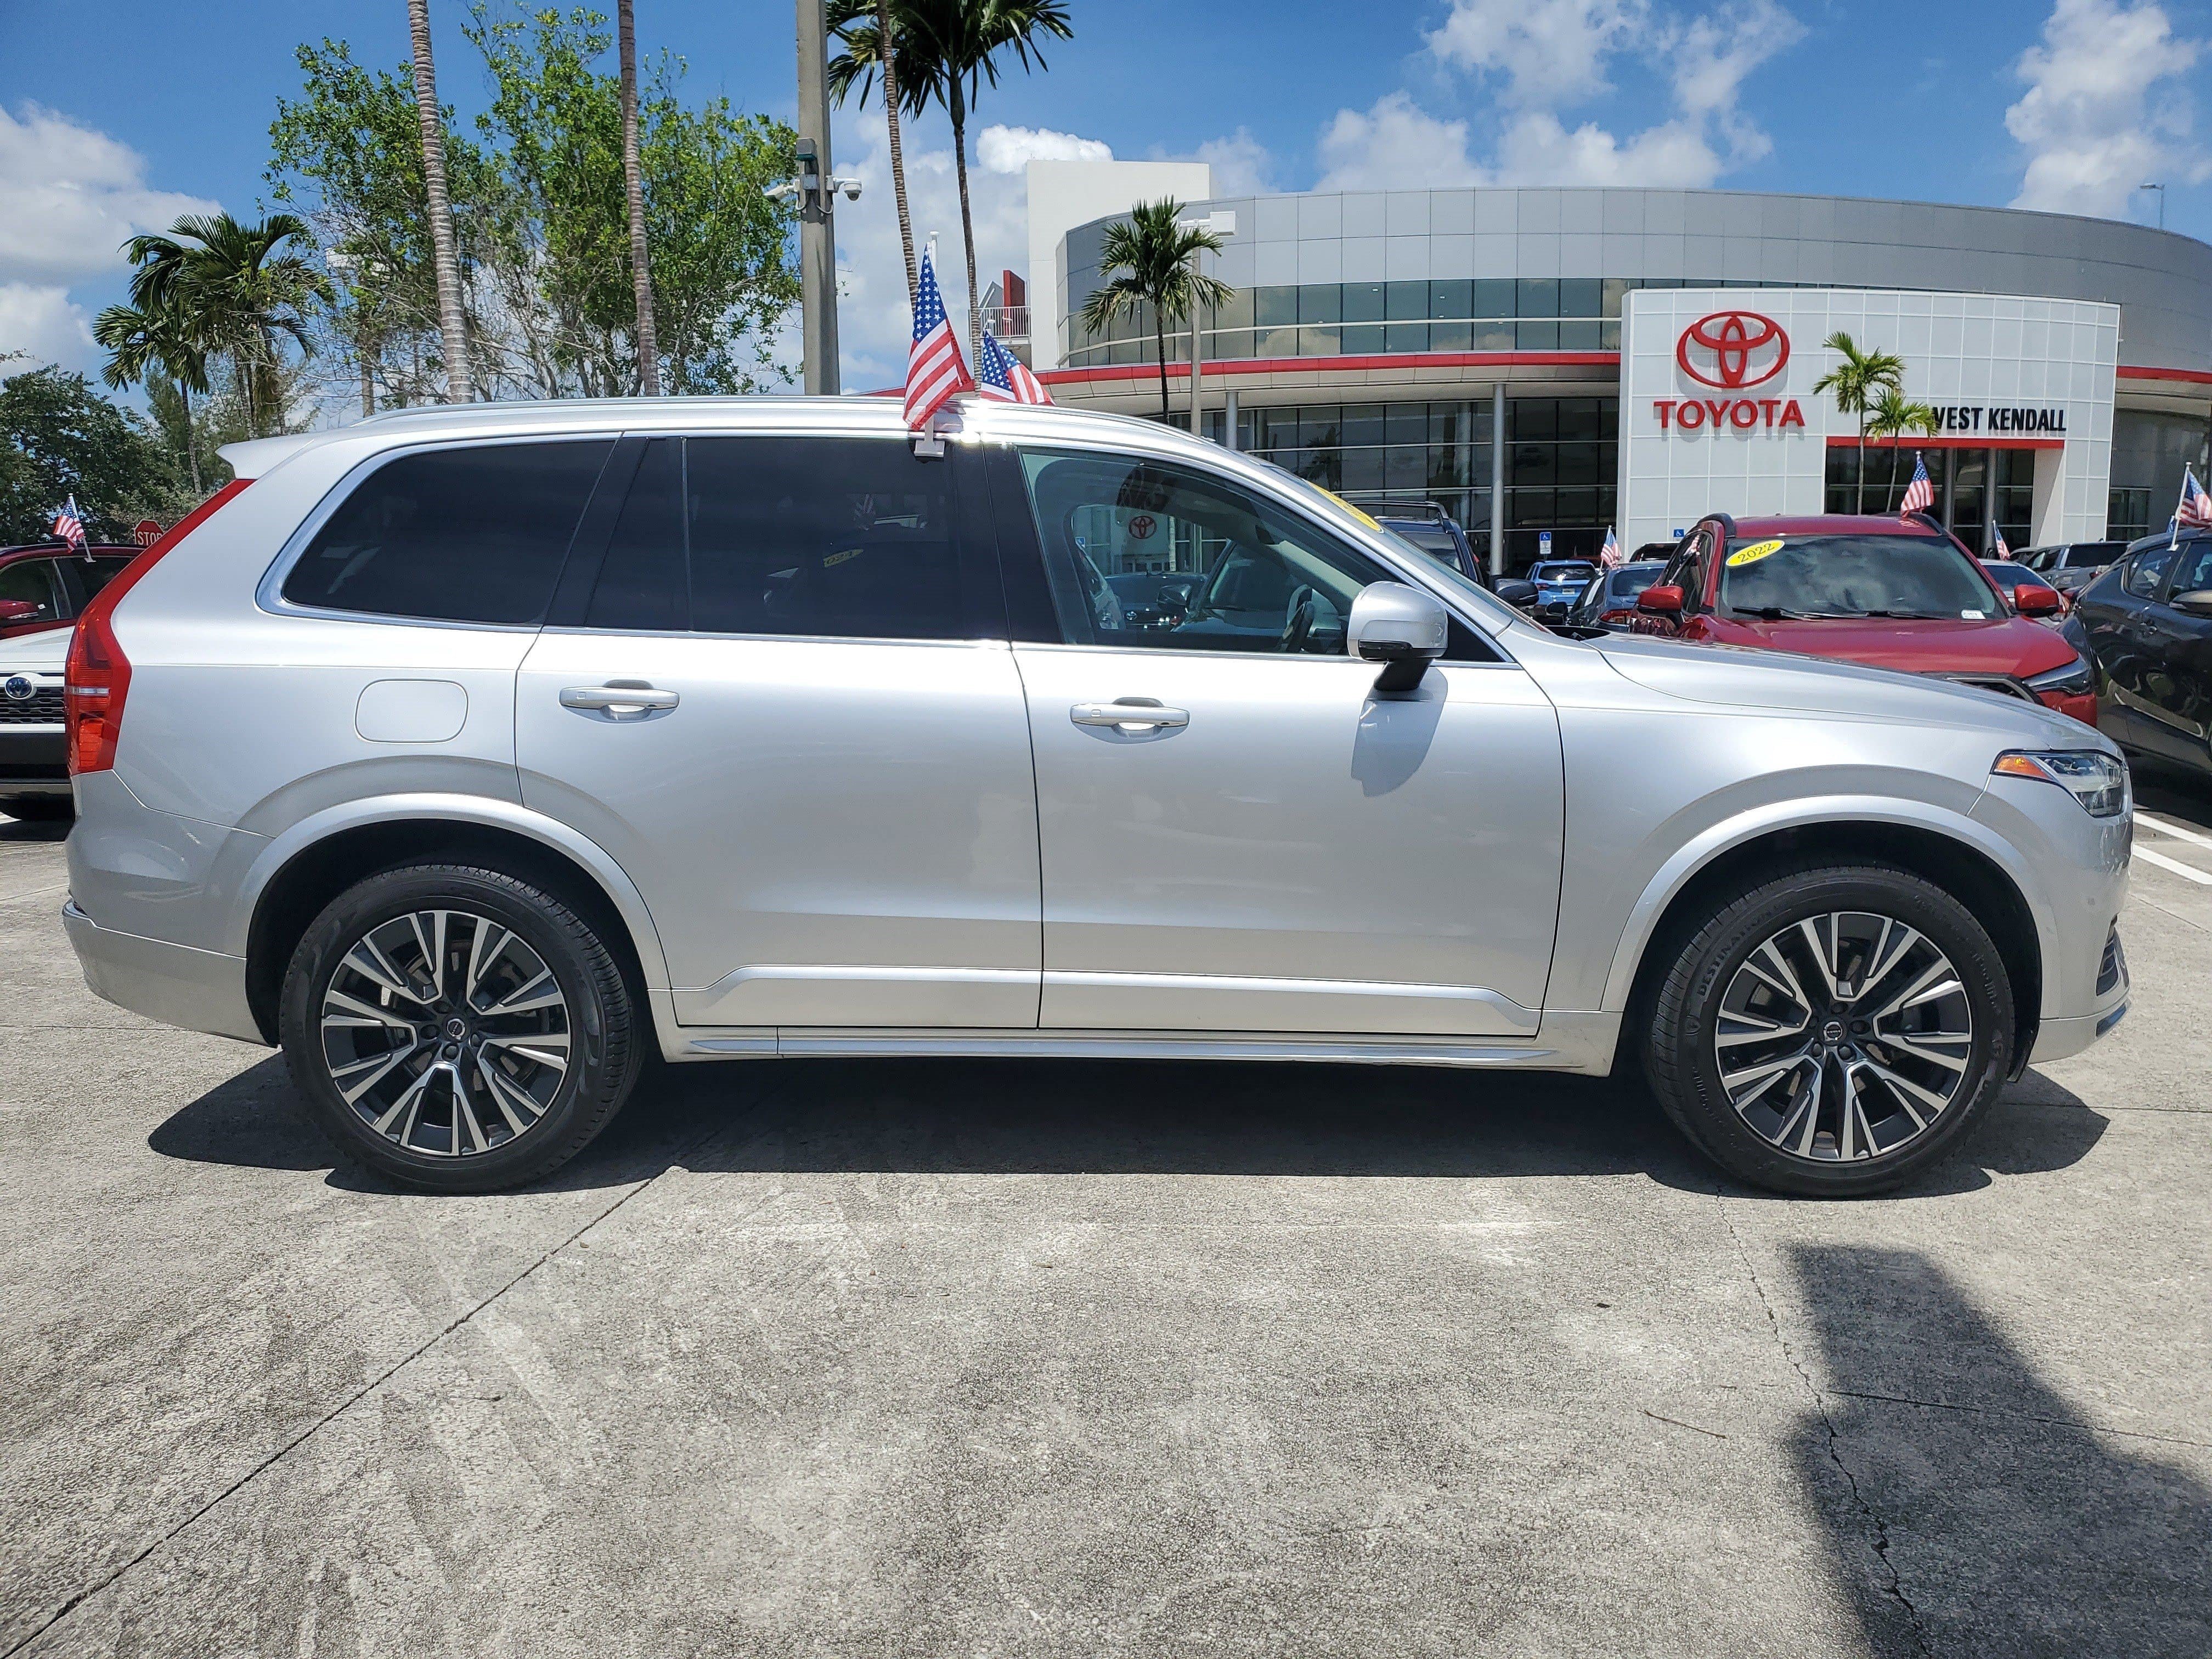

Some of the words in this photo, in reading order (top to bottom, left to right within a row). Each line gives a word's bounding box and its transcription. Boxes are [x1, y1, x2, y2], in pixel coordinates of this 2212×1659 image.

[1654, 399, 1805, 429] TOYOTA
[1988, 408, 2067, 431] KENDALL
[1737, 543, 1775, 562] 2022
